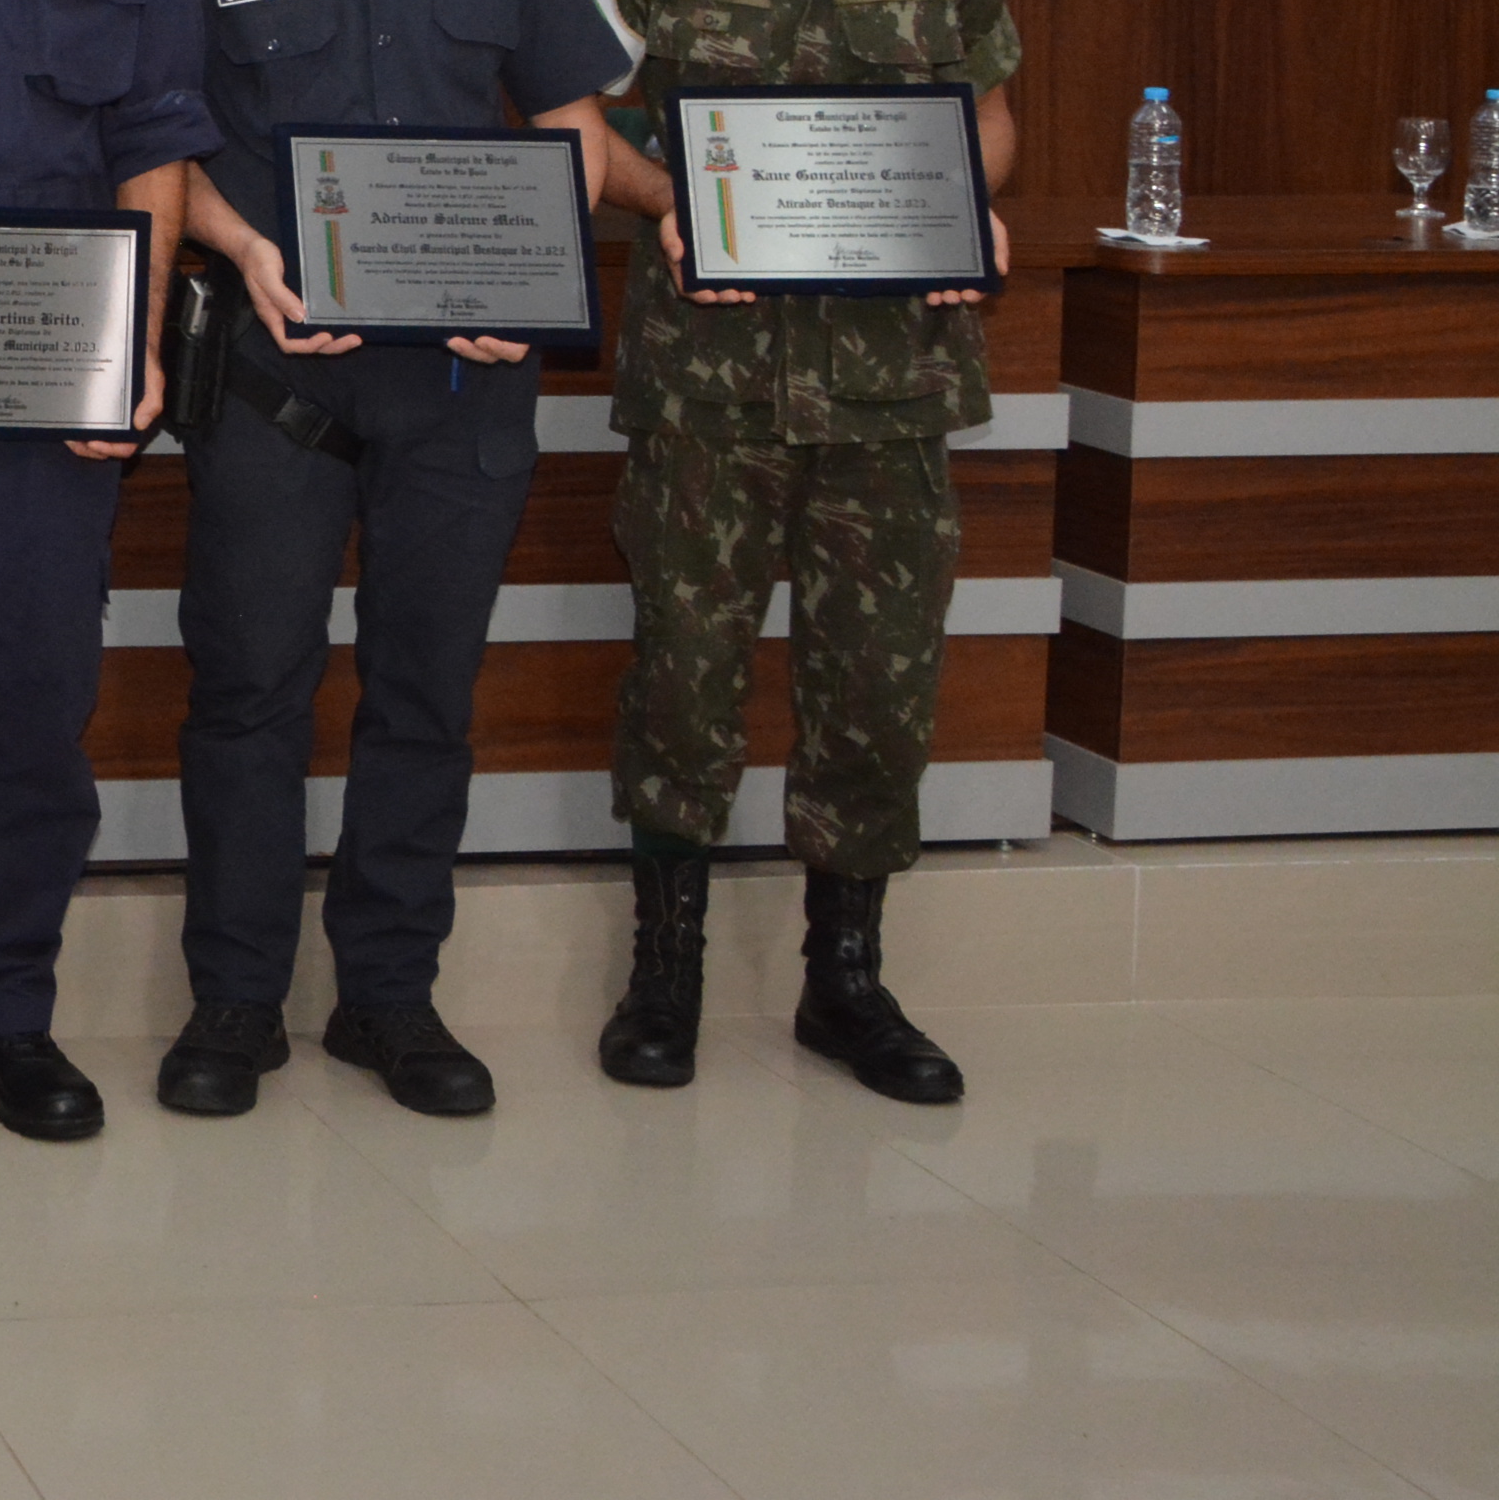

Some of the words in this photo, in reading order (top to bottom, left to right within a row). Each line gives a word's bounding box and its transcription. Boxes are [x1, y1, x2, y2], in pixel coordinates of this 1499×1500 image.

[815, 110, 858, 122] Municipal
[862, 110, 871, 121] de
[426, 153, 470, 165] Municipal
[796, 169, 875, 184] Gonçalves
[881, 168, 949, 182] Canisso,
[777, 199, 822, 209] Atirador
[827, 198, 875, 210] Destaque
[879, 198, 889, 209] de
[371, 212, 427, 224] Adriano
[434, 213, 487, 226] Saleme
[493, 214, 538, 227] Melin,
[31, 243, 41, 255] de
[350, 243, 388, 253] Guarda
[391, 243, 417, 254] Civil
[420, 244, 470, 255] Municipal
[473, 245, 517, 256] Destaque
[521, 245, 532, 256] de
[41, 312, 83, 327] Brito,
[3, 339, 58, 353] Municipal
